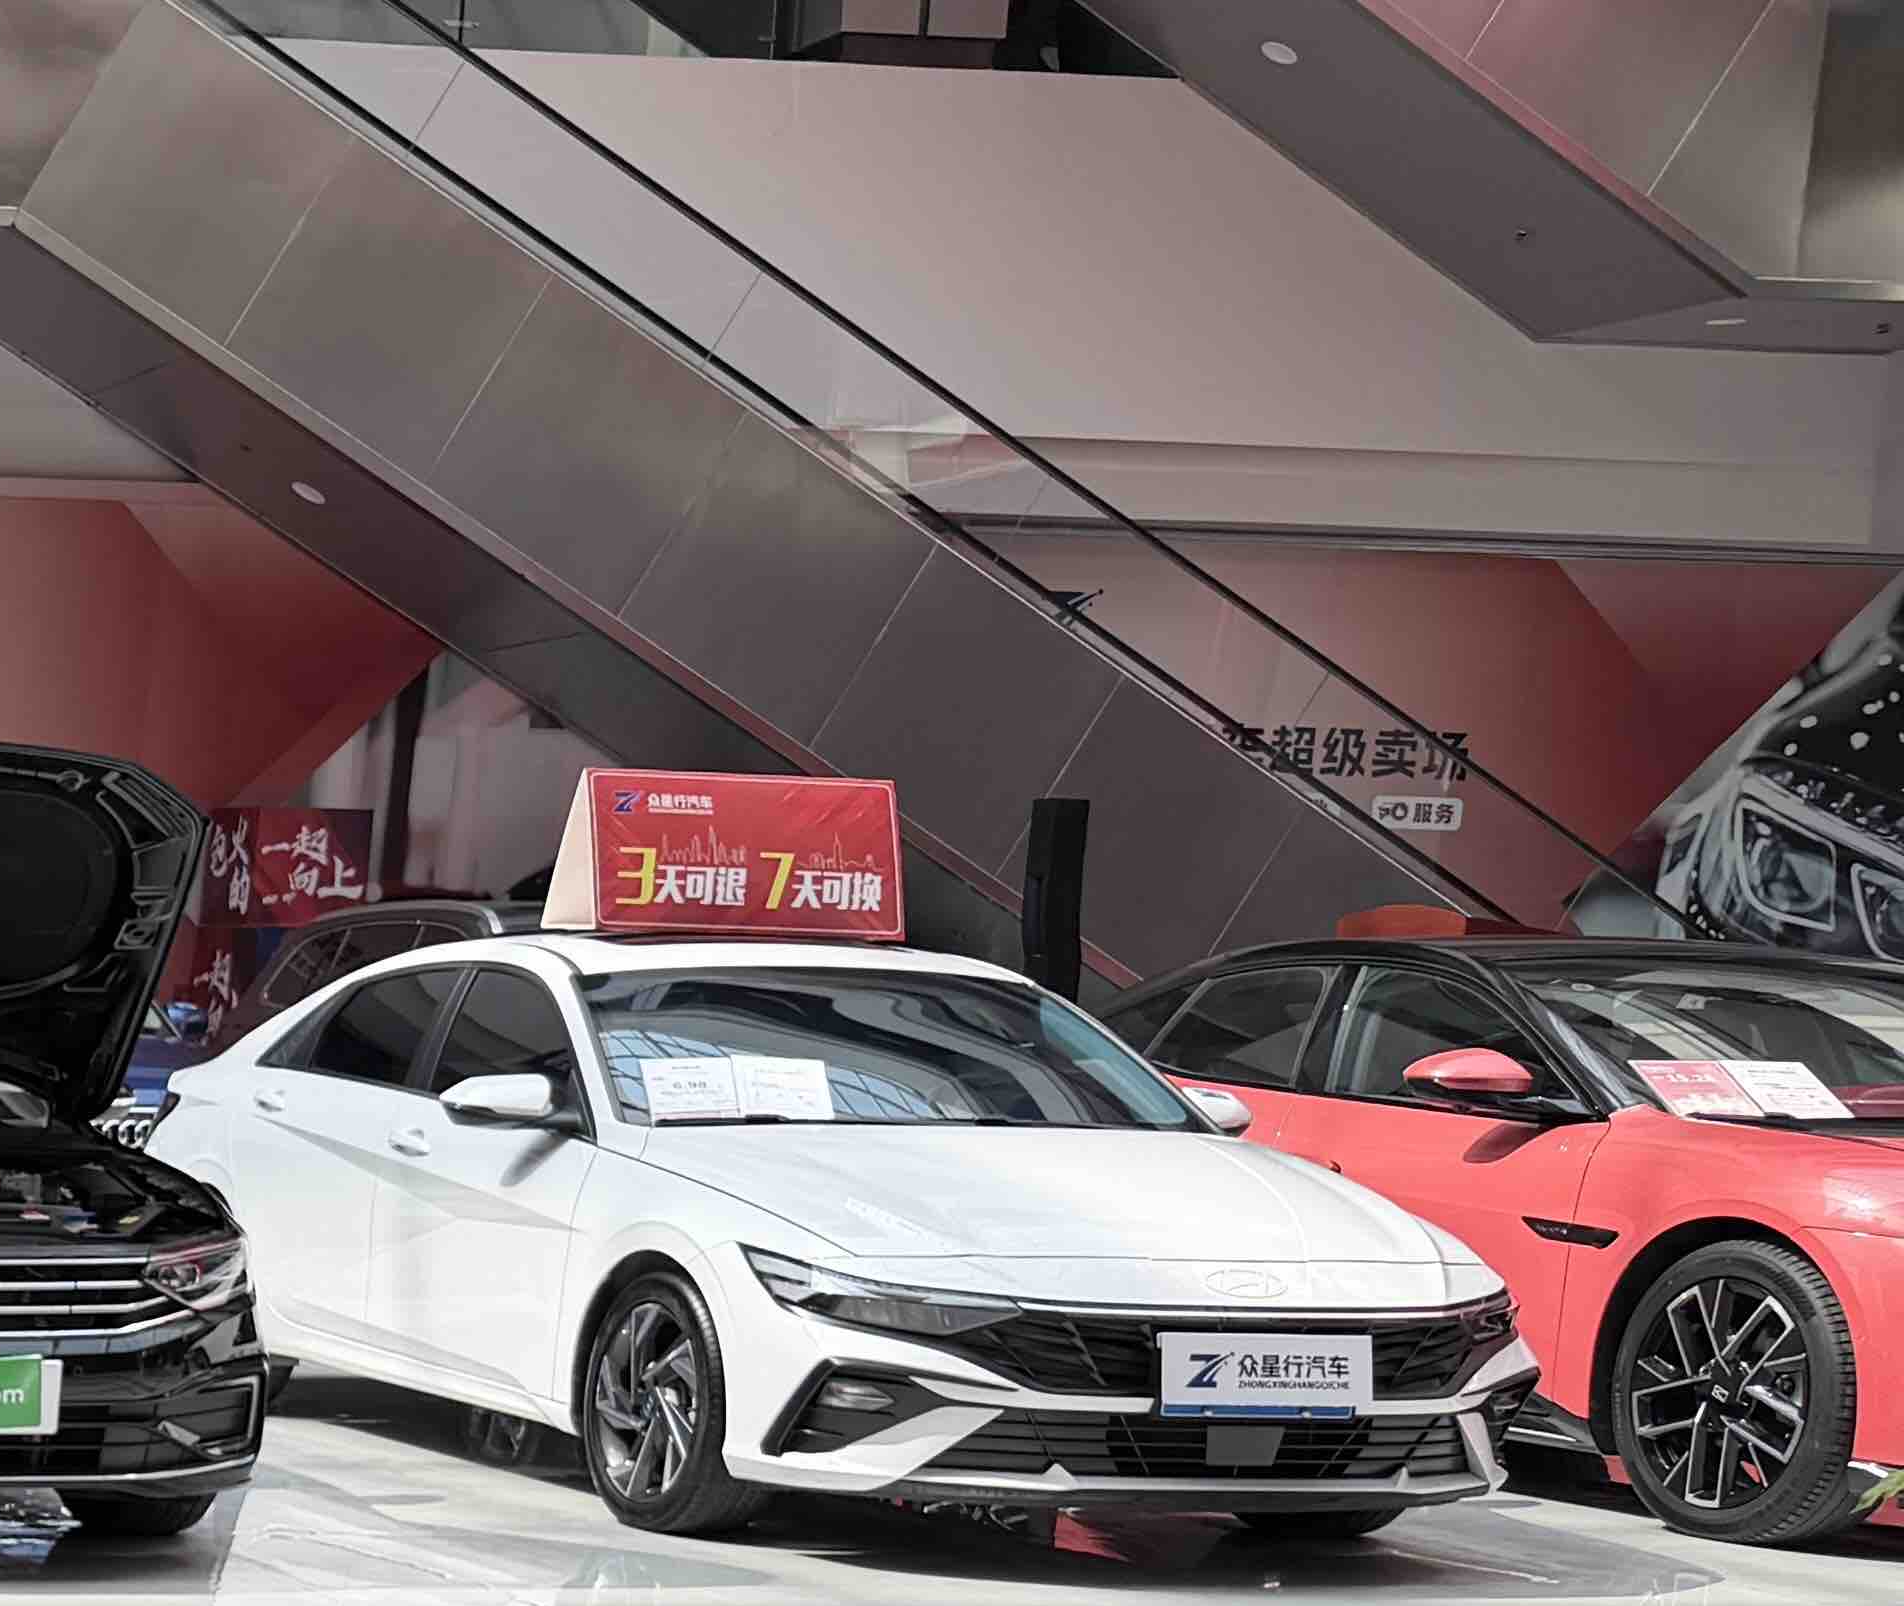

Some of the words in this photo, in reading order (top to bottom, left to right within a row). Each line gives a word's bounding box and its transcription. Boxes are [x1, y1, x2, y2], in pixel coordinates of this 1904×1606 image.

[1413, 803, 1455, 824] 服务
[616, 847, 747, 906] 3天可退
[760, 852, 882, 911] 7天可换
[1238, 1354, 1349, 1378] 众星行汽车
